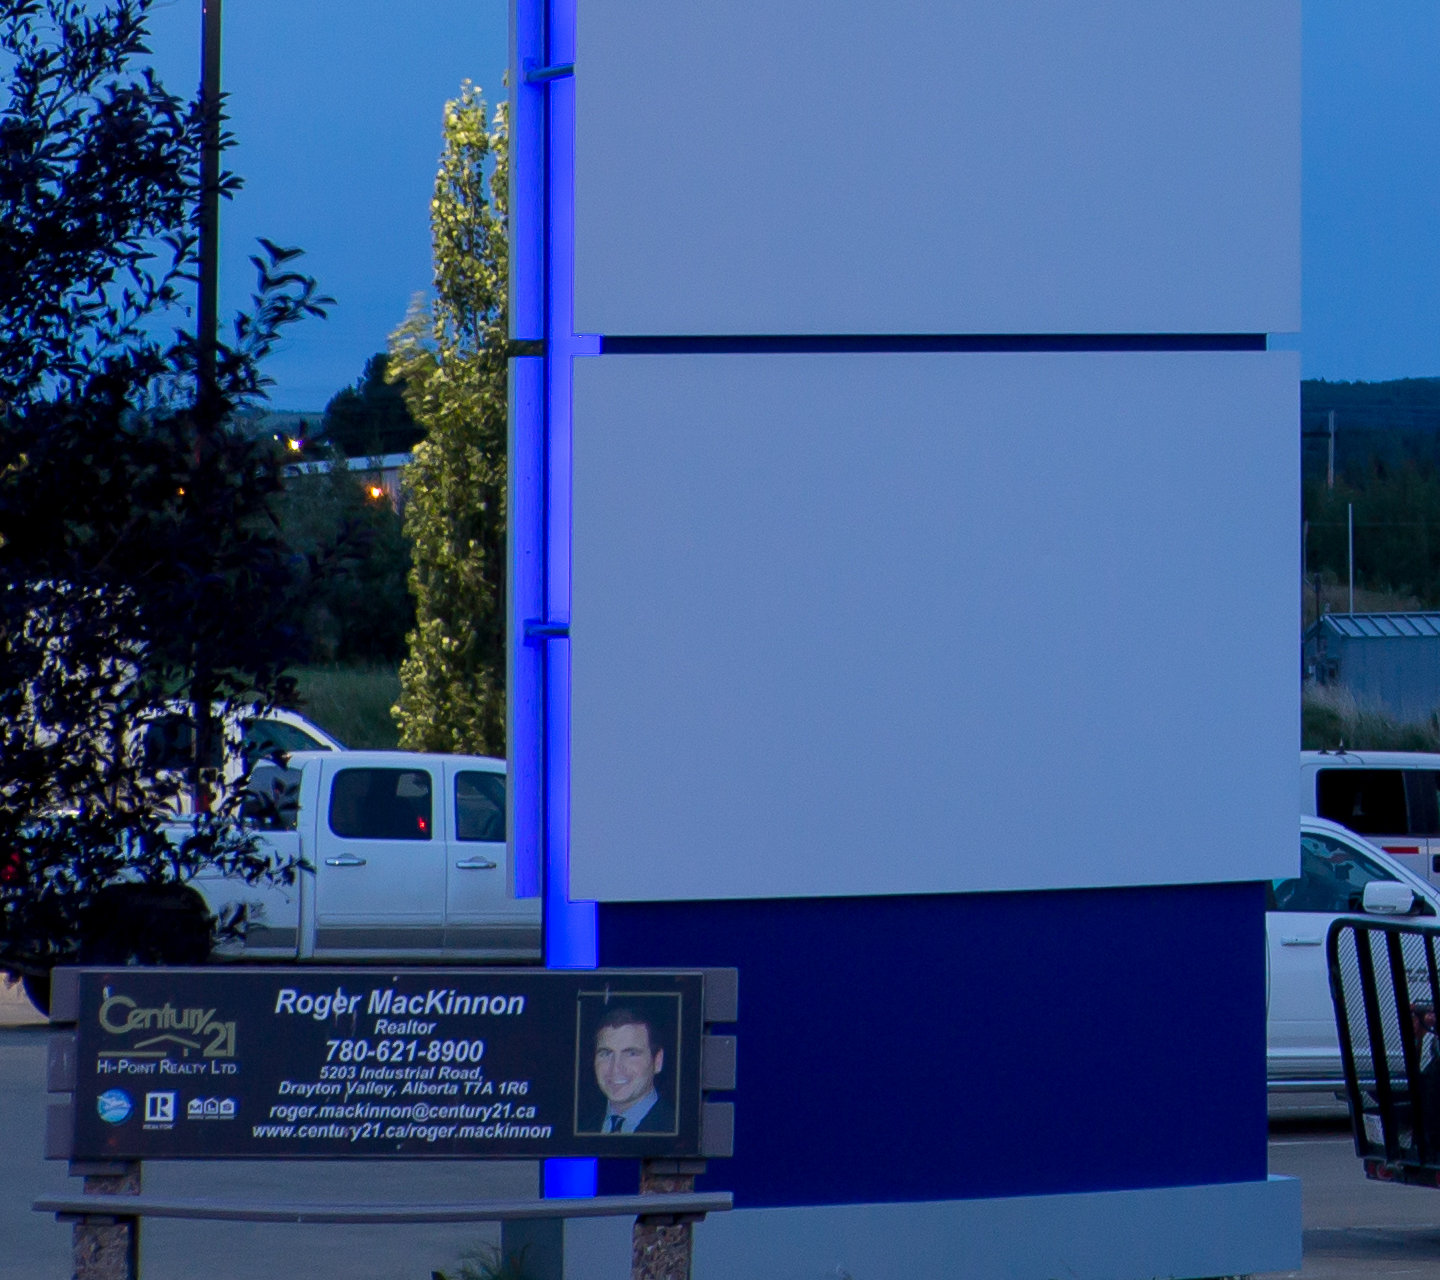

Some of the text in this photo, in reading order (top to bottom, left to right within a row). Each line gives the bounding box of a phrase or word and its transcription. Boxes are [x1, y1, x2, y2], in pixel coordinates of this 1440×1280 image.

[274, 988, 525, 1020] Roger MacKinnon
[99, 995, 217, 1035] Century
[374, 1019, 437, 1034] Realtor
[203, 1021, 237, 1057] 21
[326, 1039, 484, 1062] 780-621-8900
[319, 1065, 483, 1082] 5203 Industrial Road,
[278, 1080, 529, 1098] Drayton Valley, Alberta T7A 1R6
[269, 1102, 536, 1123] roger.mackinnon@century21.ca
[252, 1122, 552, 1142] www.century21.ca/roger.mackinnon
